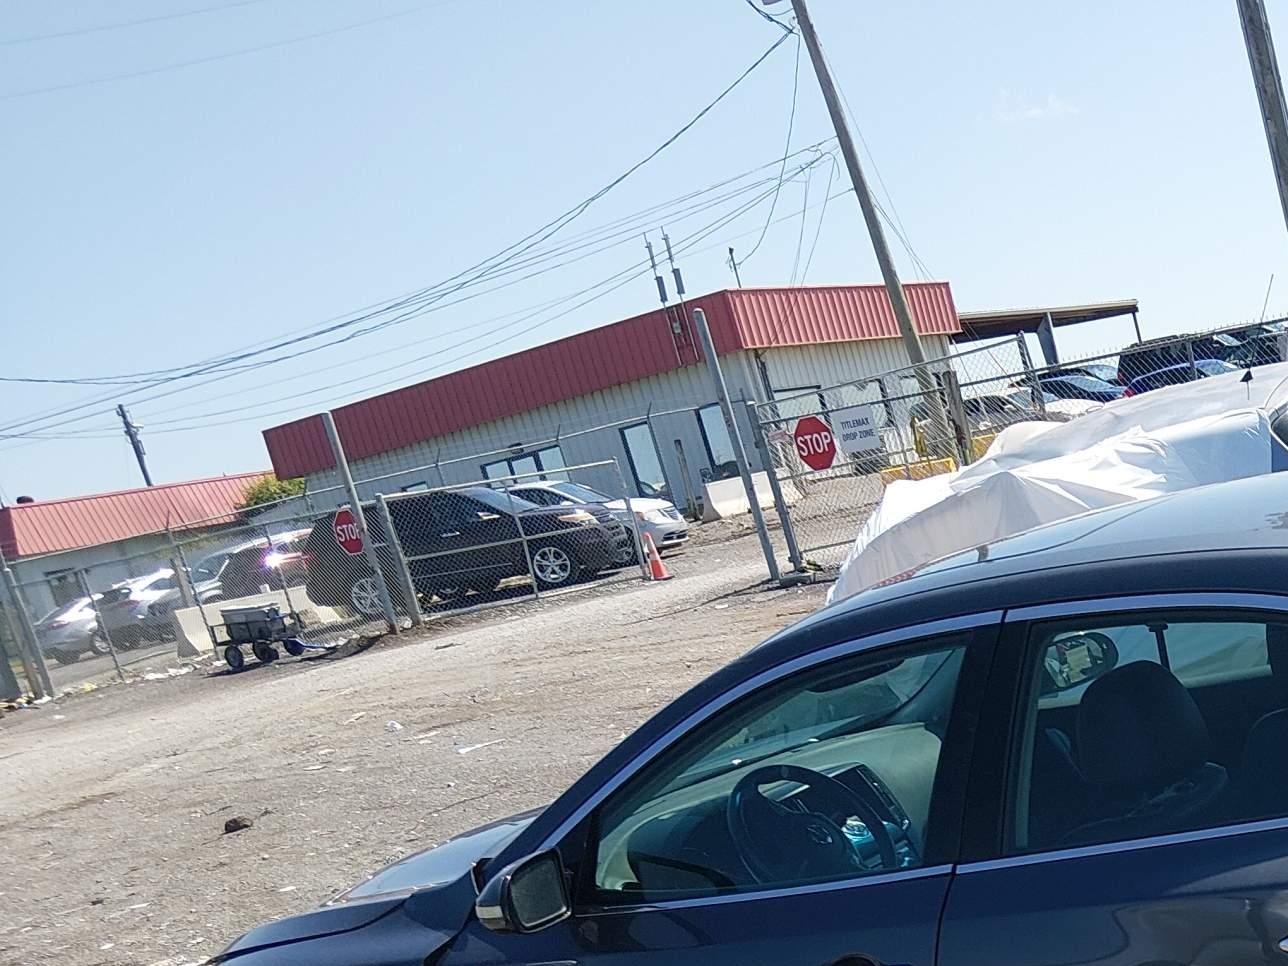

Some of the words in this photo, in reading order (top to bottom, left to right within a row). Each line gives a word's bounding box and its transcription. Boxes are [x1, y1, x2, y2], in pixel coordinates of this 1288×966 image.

[840, 417, 870, 431] TITLEMAX
[842, 432, 858, 442] DROP
[859, 428, 875, 438] ZONE
[796, 431, 832, 457] STOP
